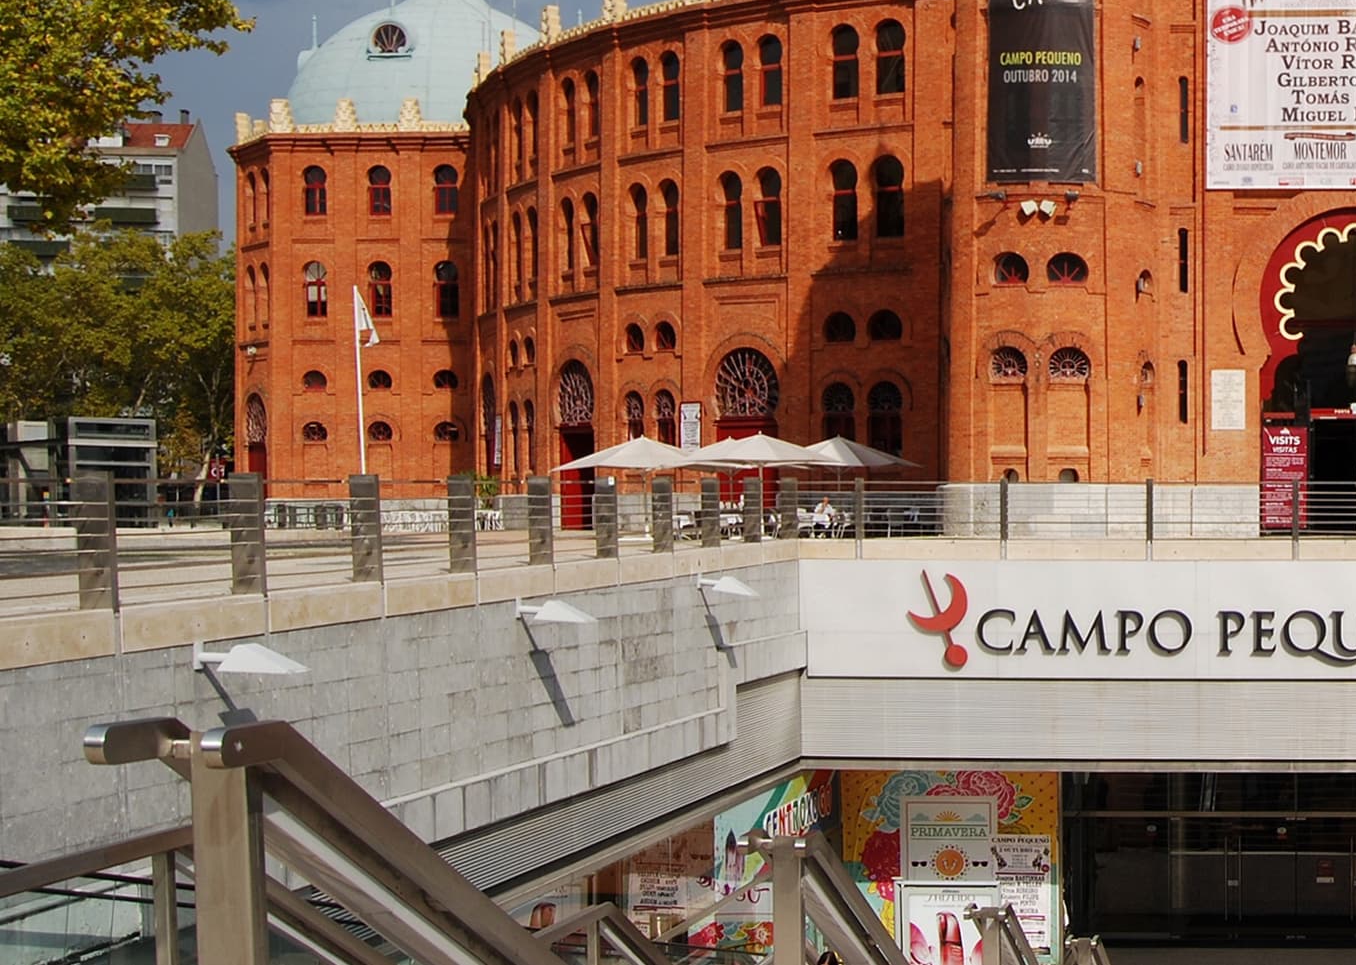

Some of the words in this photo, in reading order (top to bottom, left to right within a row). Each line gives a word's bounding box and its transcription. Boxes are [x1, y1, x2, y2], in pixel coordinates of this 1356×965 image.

[1254, 20, 1329, 38] JOAQUIM
[1265, 37, 1340, 53] ANTÓNIO
[1000, 51, 1033, 66] CAMPO
[1035, 51, 1082, 66] PEQUENO
[1280, 54, 1334, 70] VÍTOR
[1003, 69, 1049, 83] OUTUBRO
[1051, 68, 1077, 83] 2014
[1291, 89, 1350, 105] TOMÁS
[1281, 107, 1347, 122] MIGUEL
[1224, 138, 1273, 162] SANTARÉM
[1294, 141, 1347, 160] MONTEMOR
[1270, 436, 1301, 446] VISITS
[975, 608, 1193, 658] CAMPO
[910, 827, 987, 837] PRIMAVERA
